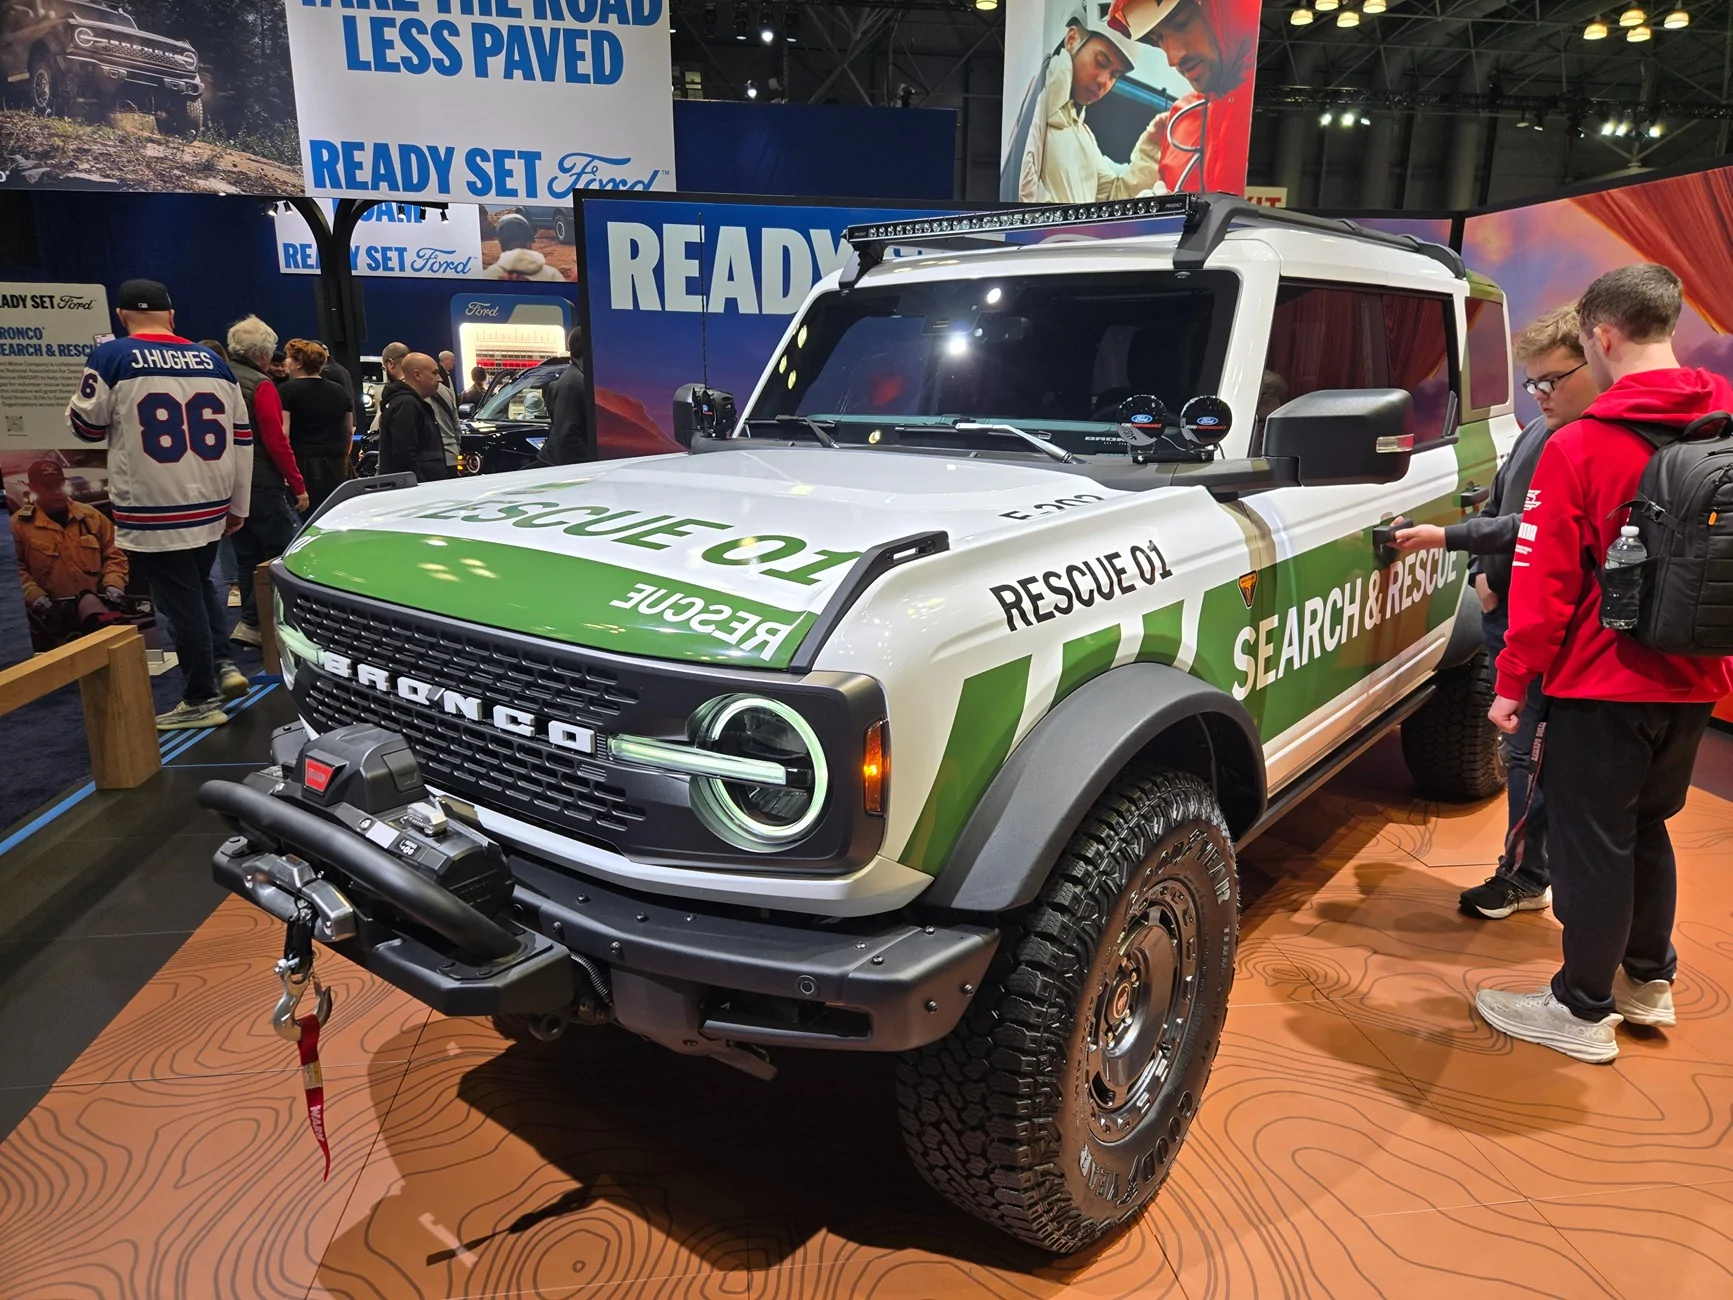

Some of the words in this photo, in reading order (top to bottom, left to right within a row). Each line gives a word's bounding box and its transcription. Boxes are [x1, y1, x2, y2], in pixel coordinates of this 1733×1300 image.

[342, 14, 463, 77] LESS
[471, 22, 624, 86] PAVED
[309, 139, 456, 195] READY
[464, 147, 542, 199] SET
[282, 243, 361, 271] REY
[365, 245, 408, 273] SET
[410, 247, 473, 275] Ford
[0, 294, 28, 309] ADY
[31, 295, 55, 310] SET
[56, 294, 95, 311] Ford
[465, 301, 500, 317] Ford
[0, 326, 44, 341] RONCO
[0, 343, 43, 357] EARCH
[45, 344, 57, 357] &
[130, 348, 214, 371] J.HUGHES
[137, 391, 227, 464] 86
[702, 535, 862, 587] 01
[989, 551, 1137, 632] RESCUE
[1130, 539, 1174, 586] 01
[1231, 577, 1362, 701] SEARCH
[1364, 569, 1383, 631] &
[1385, 548, 1458, 620] RESCUE
[324, 650, 597, 755] BRONCO
[1564, 1023, 1607, 1041] HOKA
